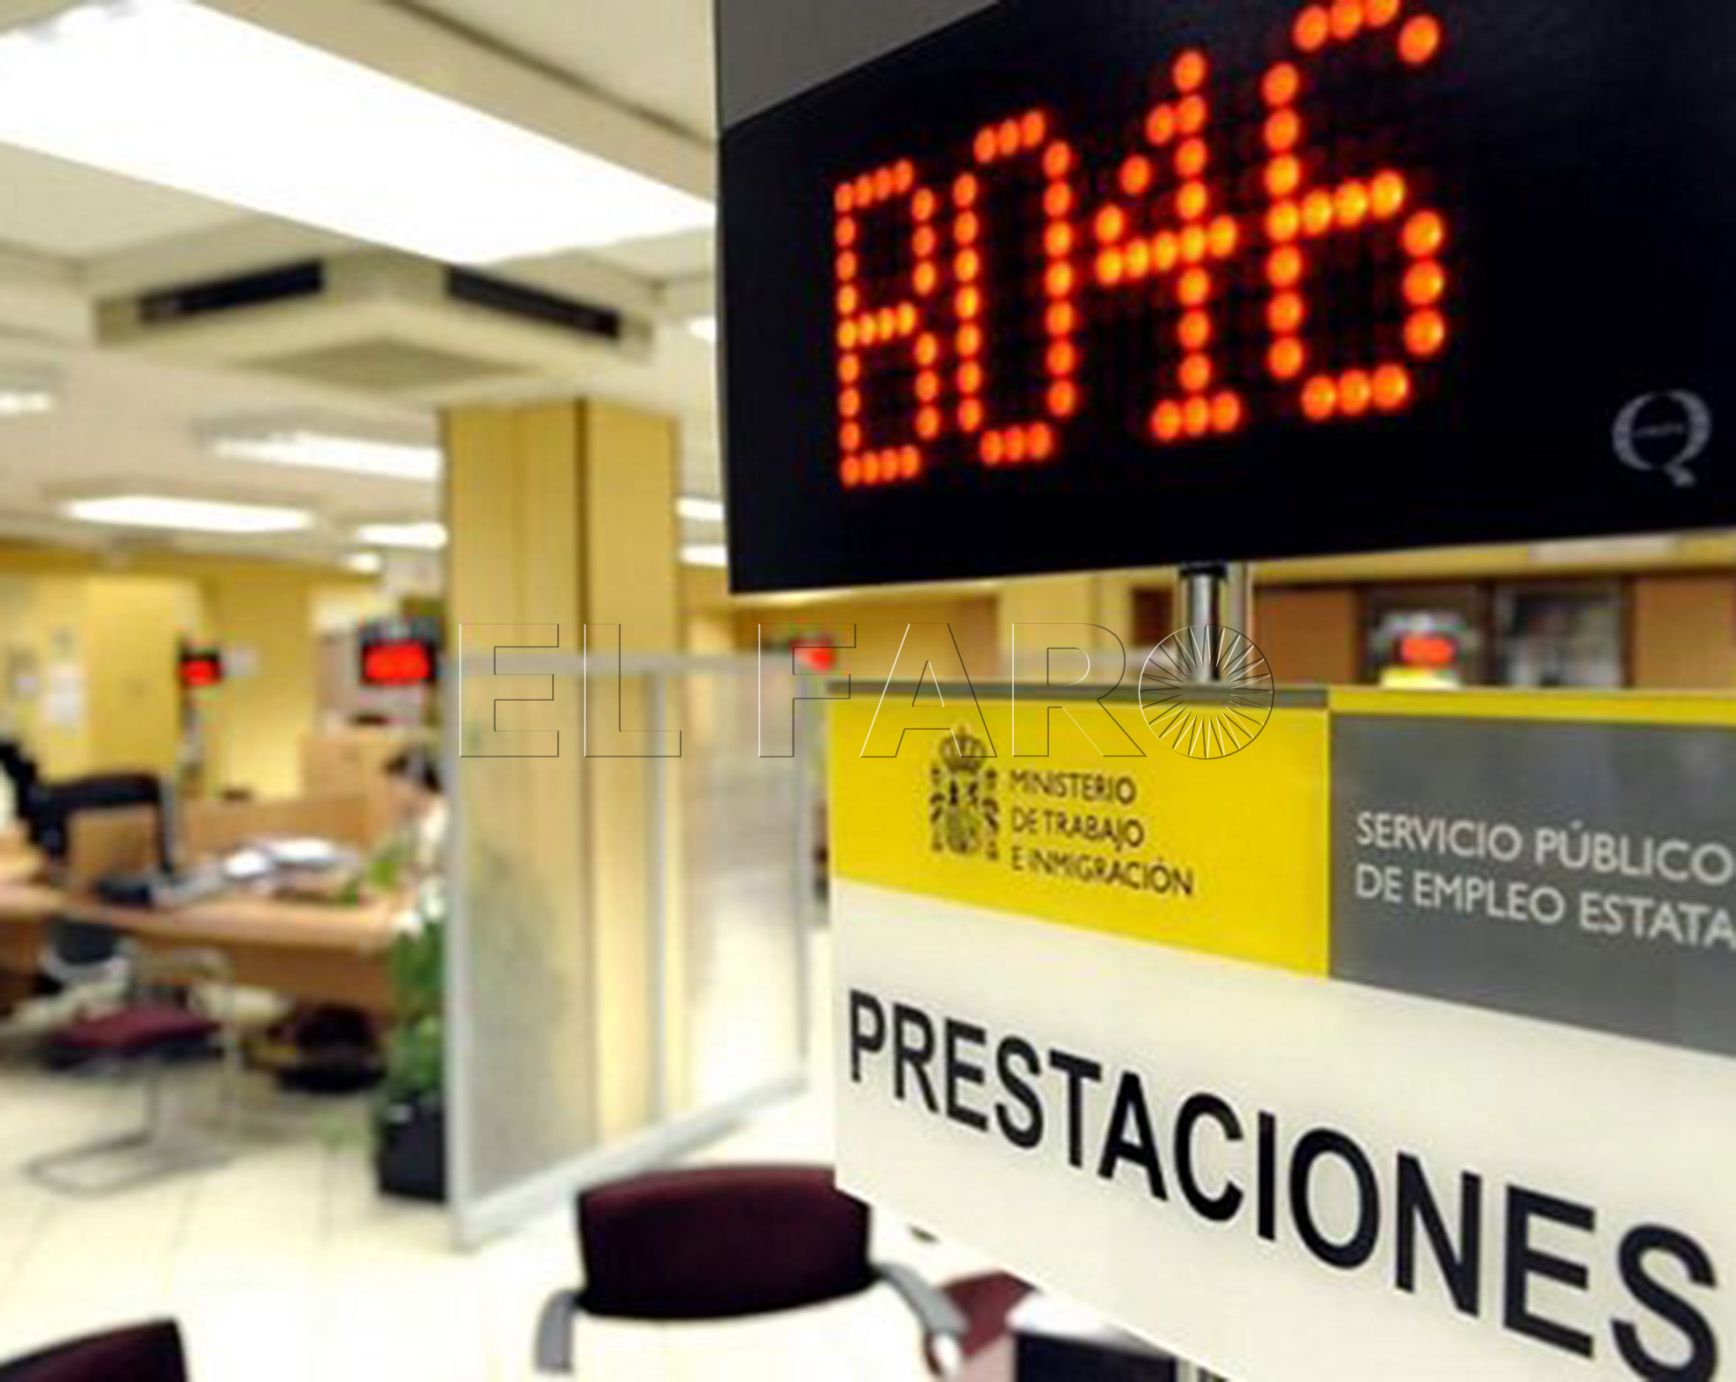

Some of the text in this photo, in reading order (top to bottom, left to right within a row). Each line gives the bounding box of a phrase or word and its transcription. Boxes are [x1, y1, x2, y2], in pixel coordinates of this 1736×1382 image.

[1009, 768, 1137, 805] MINISTERIO
[1011, 807, 1145, 851] DE TRABAJO
[1356, 811, 1735, 885] SERVICIO PÚBLICO
[1011, 846, 1194, 897] E INMIGRACIÓN
[1356, 863, 1403, 900] DE
[1413, 870, 1565, 925] EMPLEO
[848, 988, 1718, 1382] PRESTACIONES
